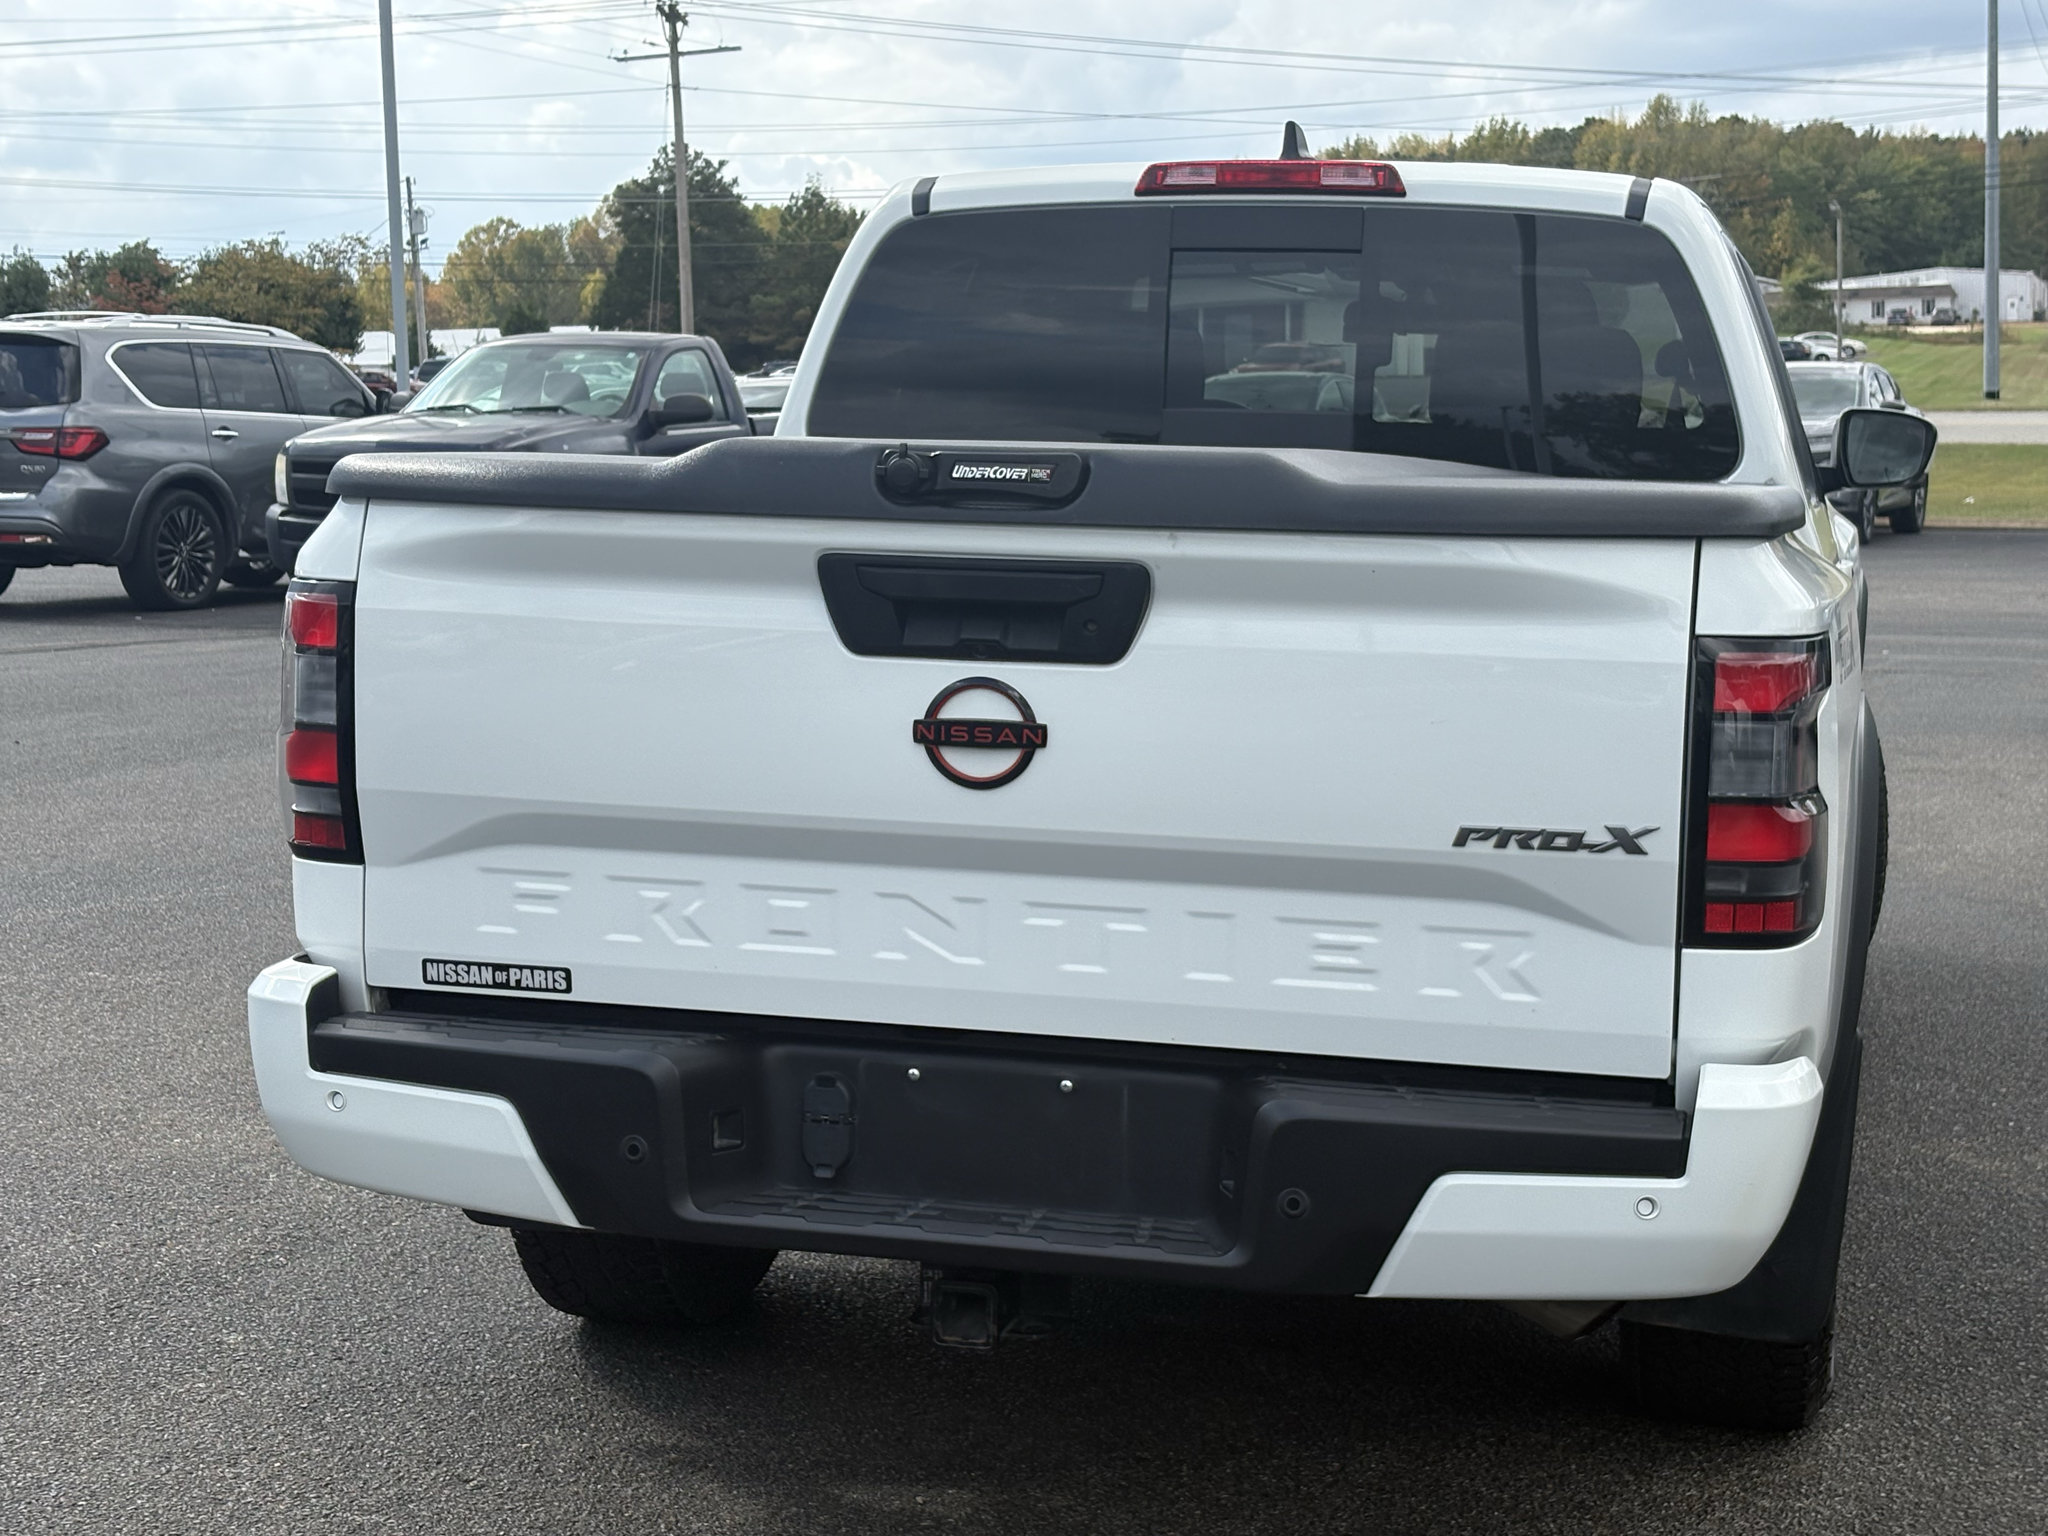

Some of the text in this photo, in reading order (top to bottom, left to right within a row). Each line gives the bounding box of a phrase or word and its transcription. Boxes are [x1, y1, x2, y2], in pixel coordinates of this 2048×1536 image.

[916, 724, 1042, 745] NISSAN
[476, 866, 1540, 1002] FRONTIER
[426, 962, 567, 990] NISSAN OF PARIS
